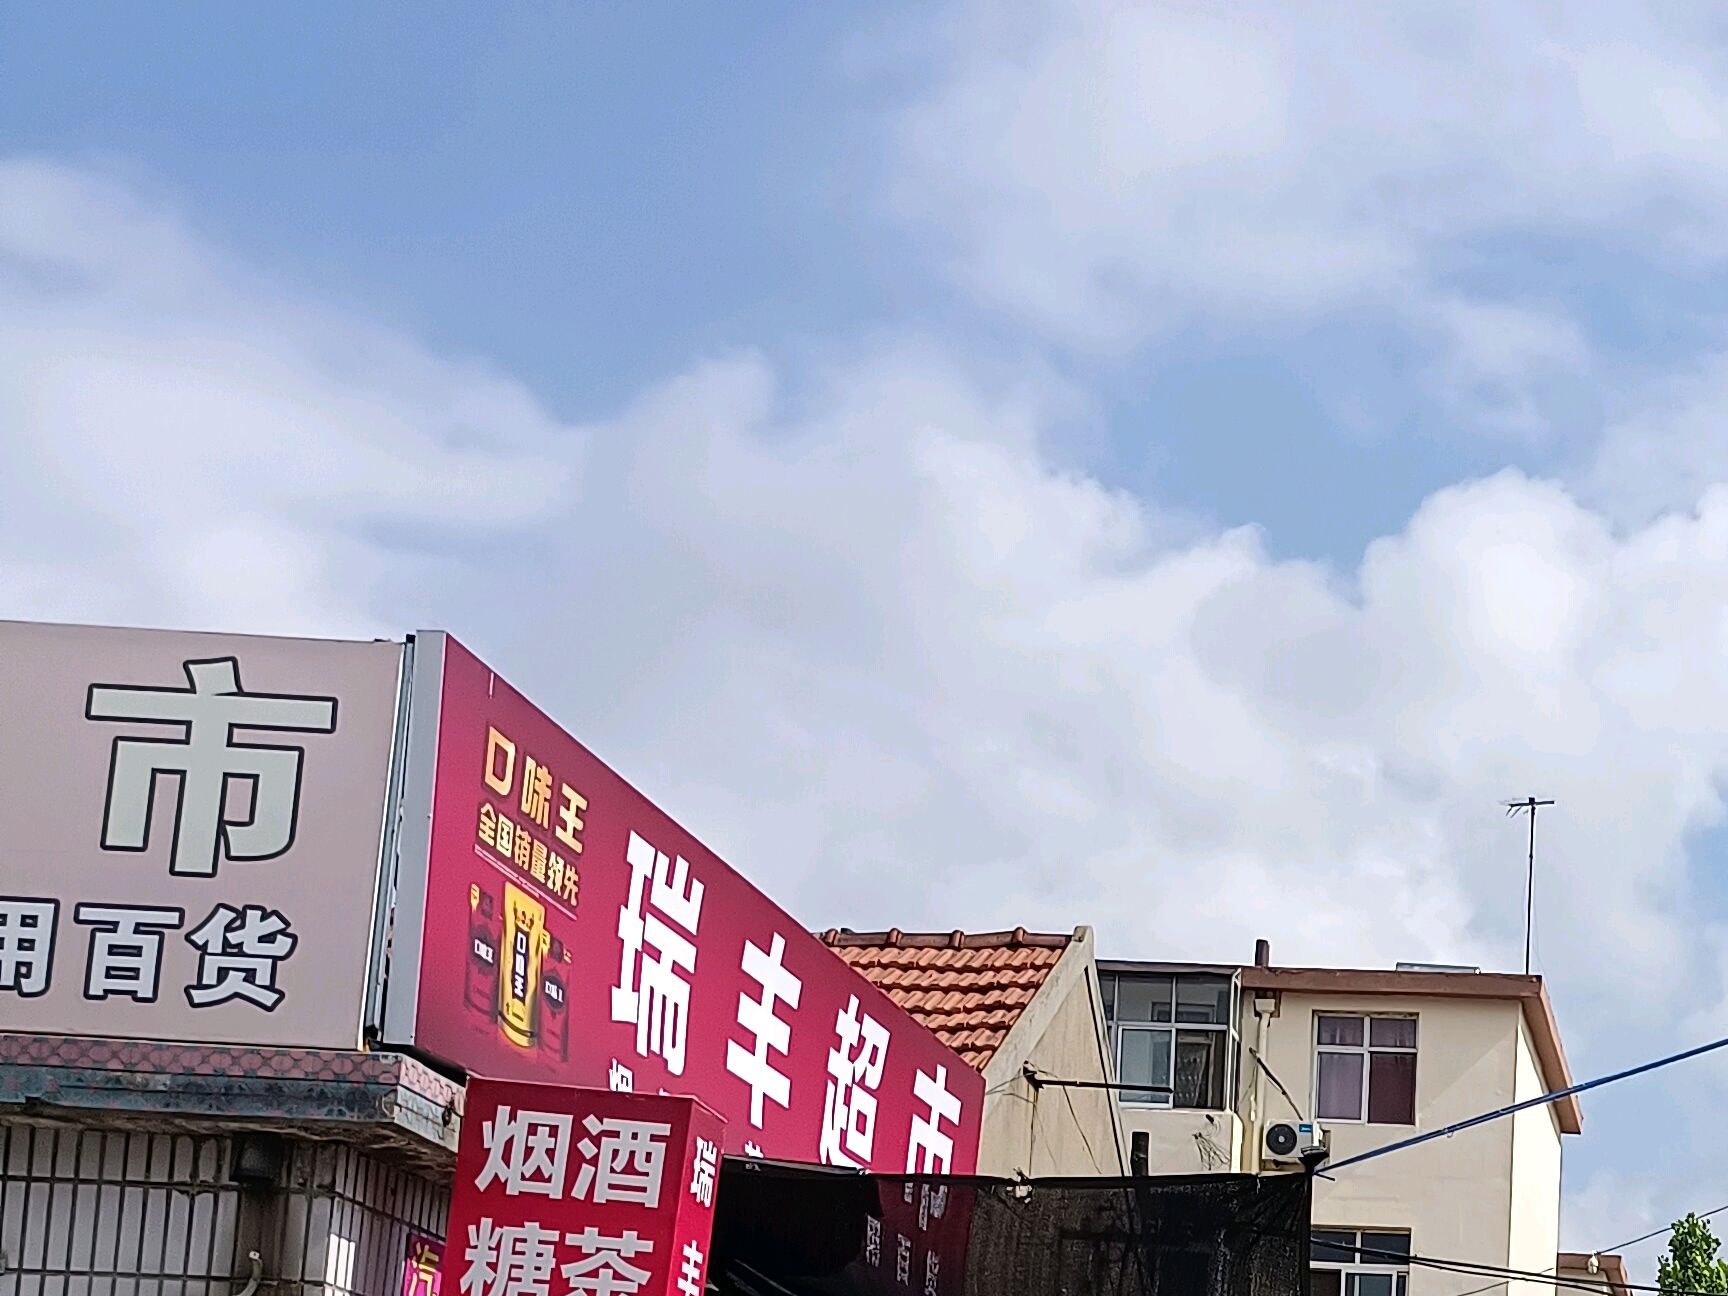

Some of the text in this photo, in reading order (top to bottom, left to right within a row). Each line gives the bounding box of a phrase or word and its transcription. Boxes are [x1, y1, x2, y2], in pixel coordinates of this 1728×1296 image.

[84, 656, 338, 878] 市
[484, 726, 588, 854] 口味王
[478, 802, 579, 907] 全国销量领先
[610, 829, 962, 1178] 瑞丰超市
[475, 1104, 671, 1209] 烟酒
